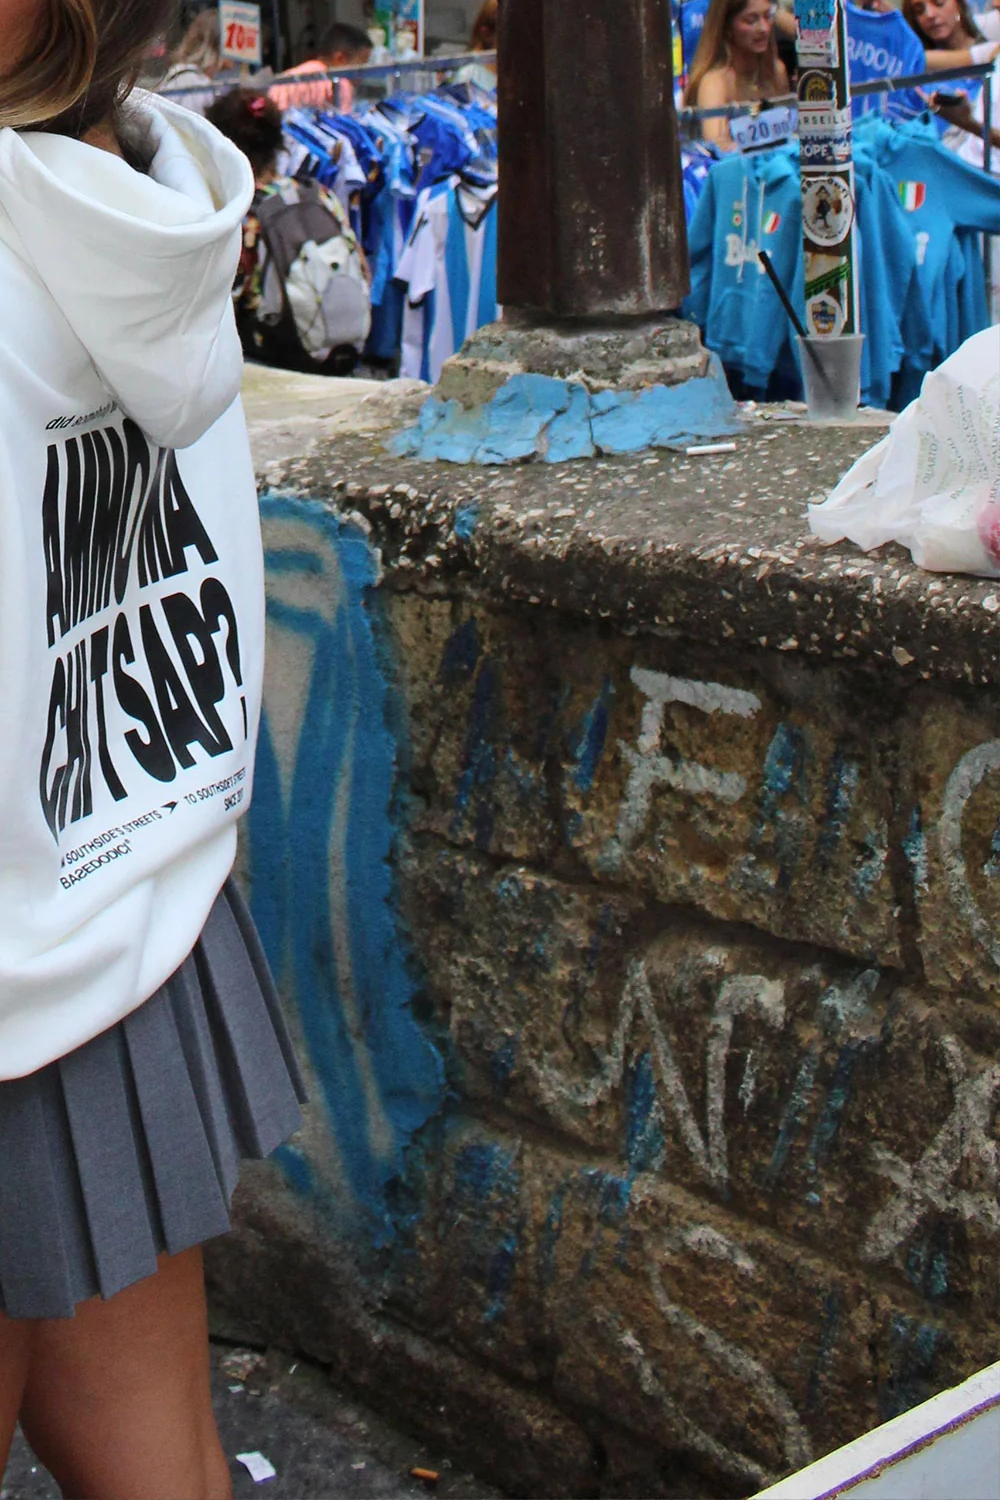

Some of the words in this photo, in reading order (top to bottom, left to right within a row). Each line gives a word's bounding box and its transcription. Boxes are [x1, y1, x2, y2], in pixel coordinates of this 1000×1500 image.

[748, 122, 769, 142] 20
[122, 810, 163, 833] STREETS
[184, 793, 198, 805] TO
